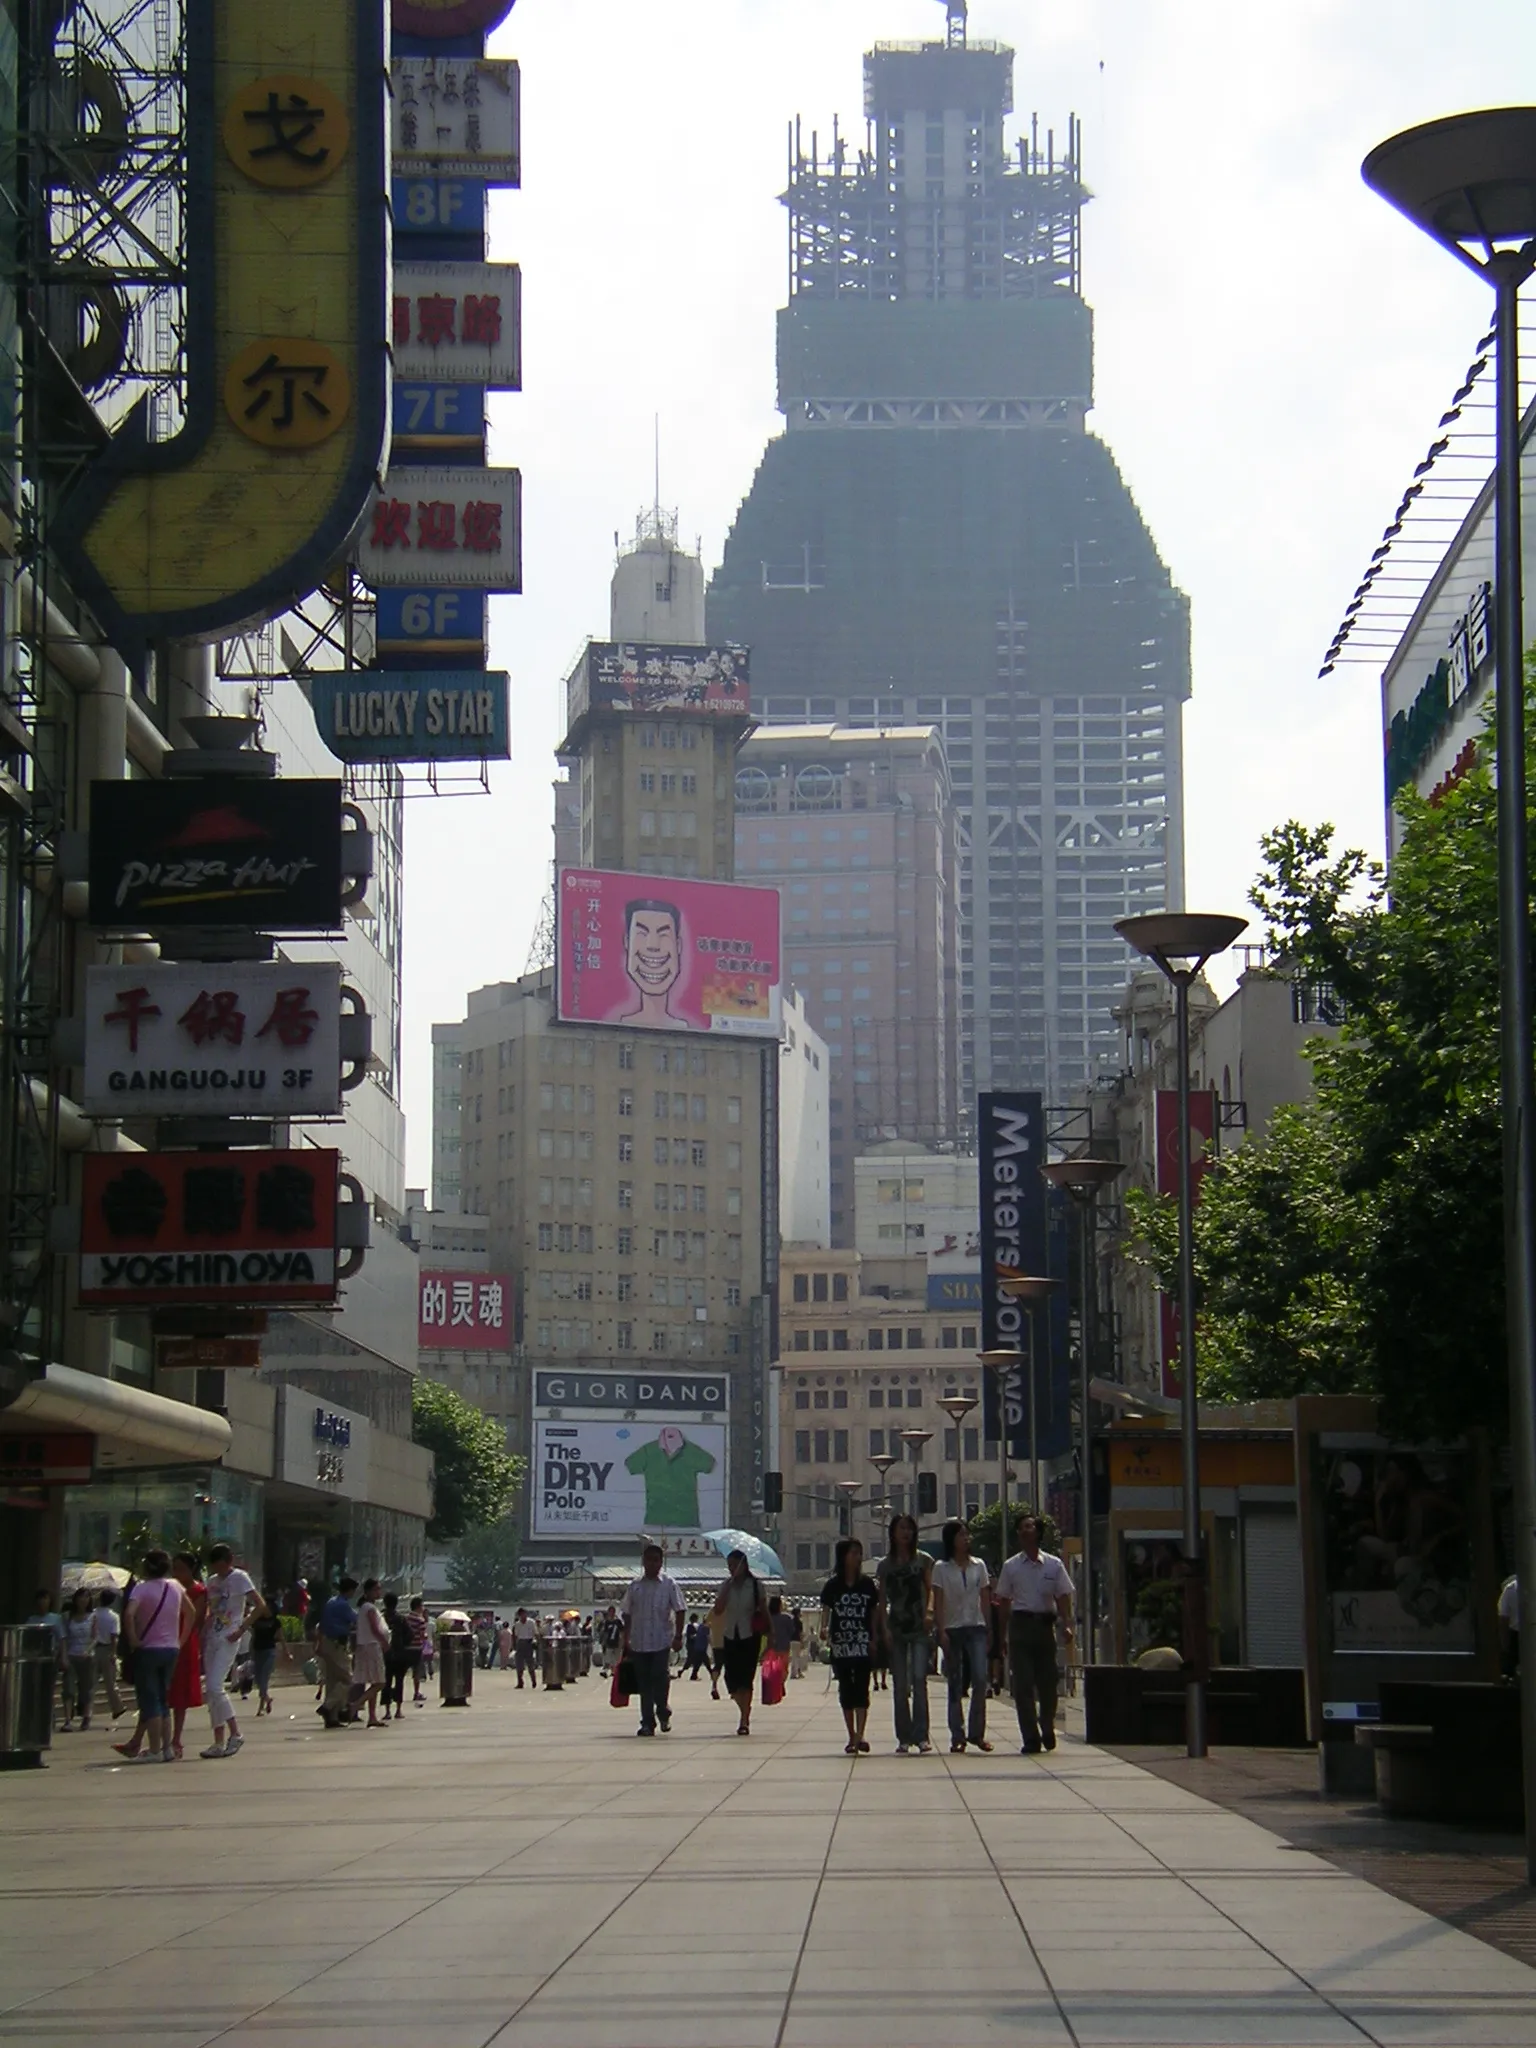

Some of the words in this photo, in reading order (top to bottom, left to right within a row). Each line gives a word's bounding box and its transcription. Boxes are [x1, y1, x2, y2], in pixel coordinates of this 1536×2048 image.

[406, 184, 465, 226] 8F
[402, 388, 459, 430] 7F
[370, 497, 503, 552] 欢迎您
[401, 594, 459, 635] 6F
[335, 690, 419, 737] LUCKY
[426, 688, 493, 736] STAR
[232, 856, 318, 888] Hut
[586, 898, 602, 970] 开心加倍
[109, 1069, 266, 1092] GANGUOJU
[282, 1069, 313, 1090] 3F
[422, 1279, 503, 1328] 的灵魂
[547, 1379, 720, 1401] GIORDANO
[545, 1443, 581, 1460] The
[544, 1461, 614, 1490] DRY
[544, 1491, 586, 1509] Polo
